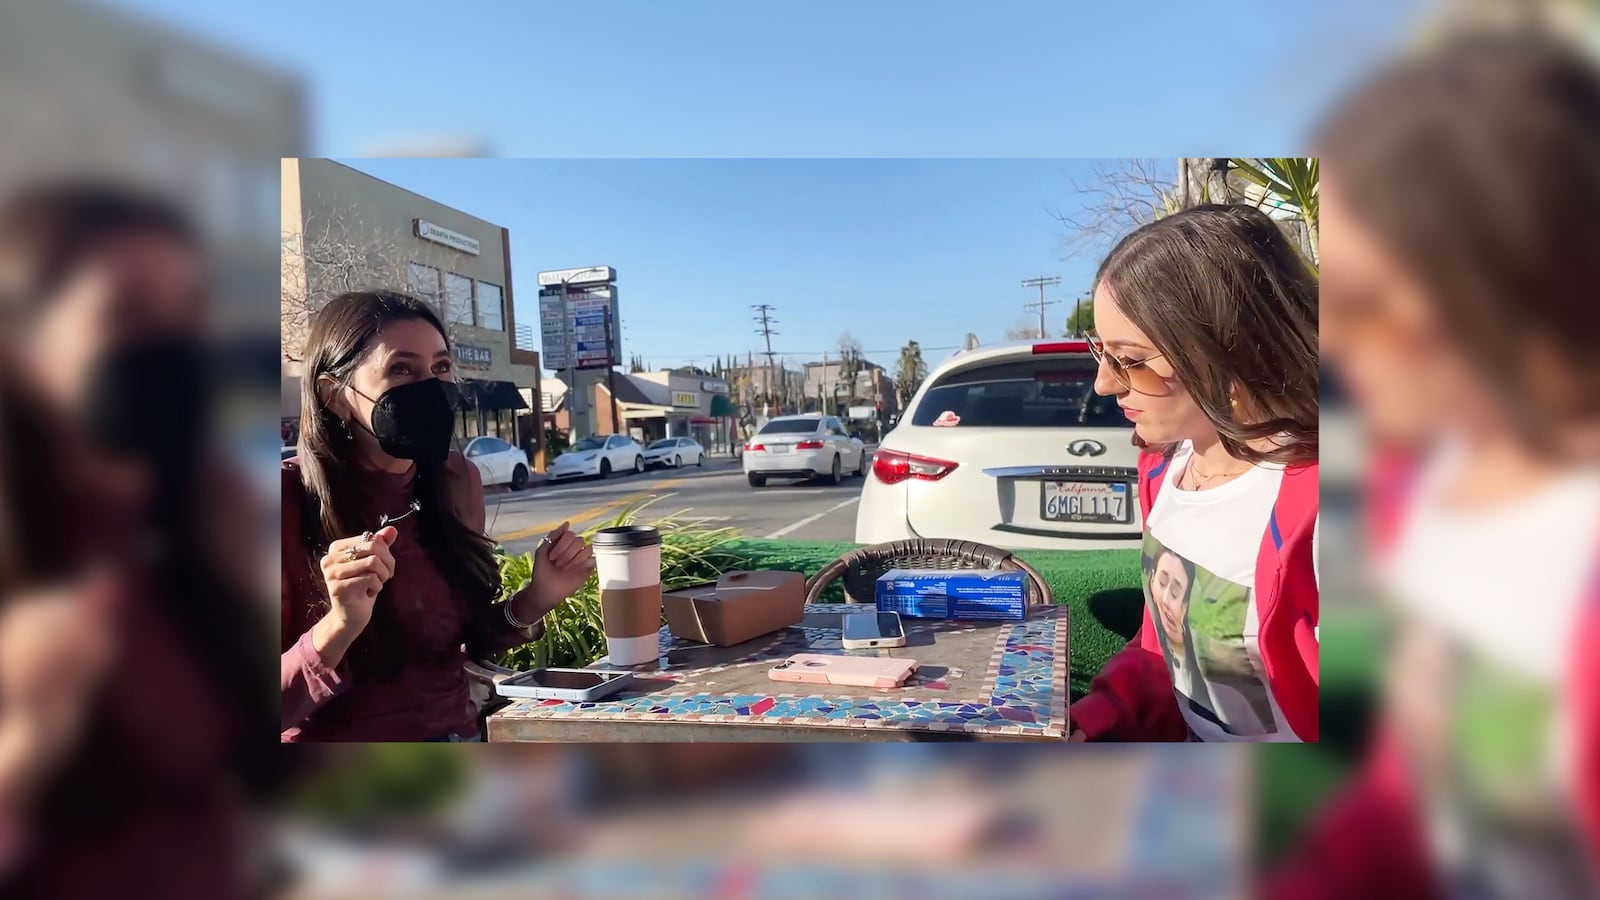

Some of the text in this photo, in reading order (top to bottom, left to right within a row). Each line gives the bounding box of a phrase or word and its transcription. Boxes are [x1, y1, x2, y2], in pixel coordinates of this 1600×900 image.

[449, 234, 479, 250] PRODUCTIONS
[456, 346, 490, 362] THE BAR
[1059, 483, 1107, 495] California
